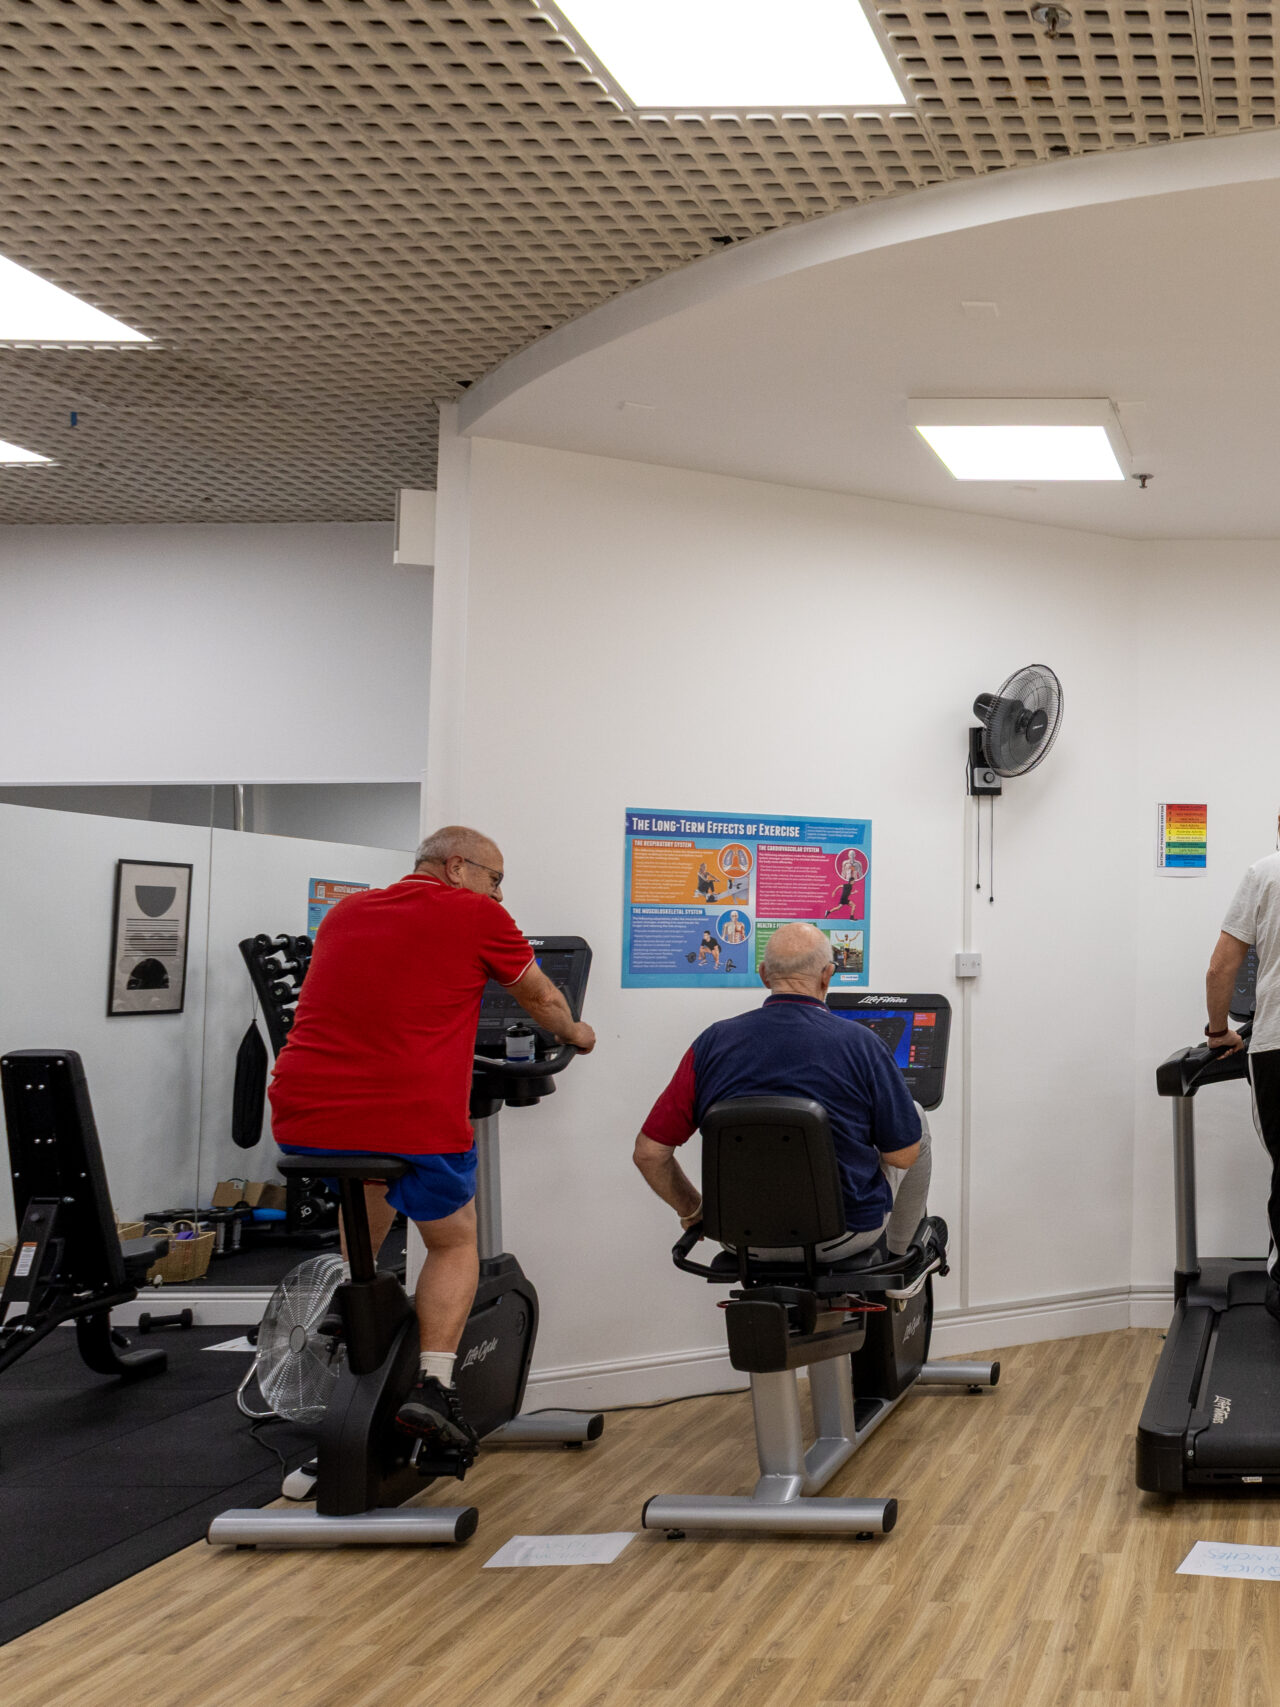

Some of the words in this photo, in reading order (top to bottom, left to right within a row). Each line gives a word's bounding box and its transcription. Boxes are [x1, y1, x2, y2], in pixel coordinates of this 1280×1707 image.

[632, 817, 650, 831] THE
[652, 818, 705, 833] LONG-TERM
[707, 821, 744, 835] EFFECTS
[746, 824, 758, 835] OF
[759, 823, 800, 837] EXERCISE
